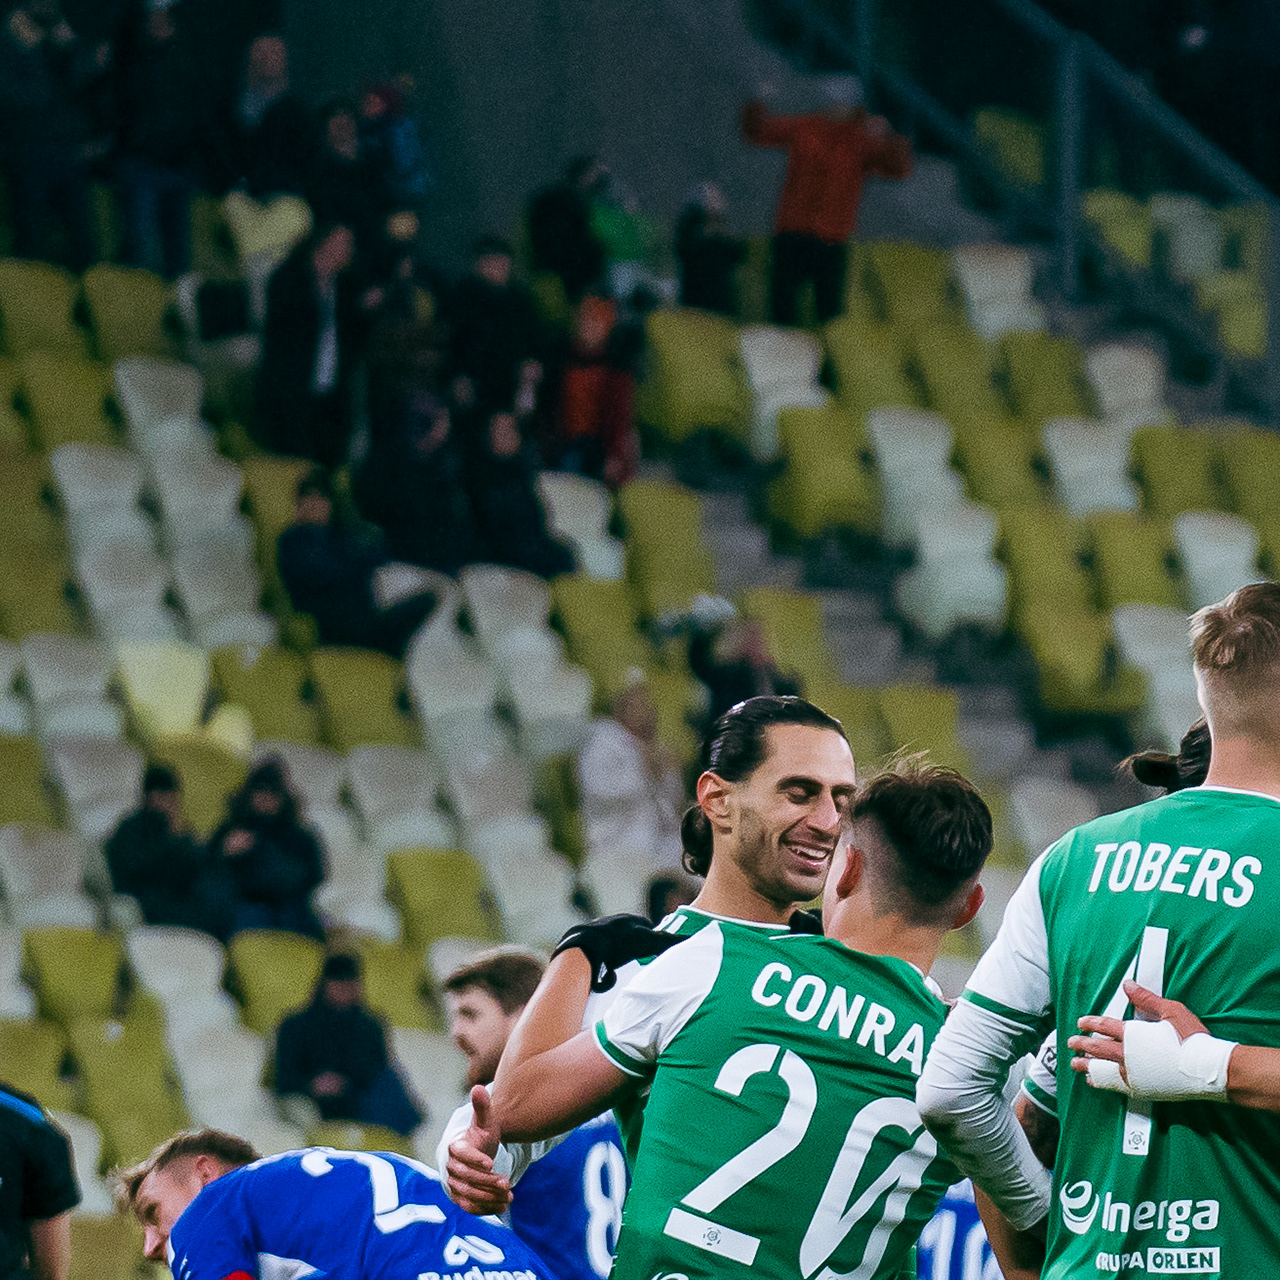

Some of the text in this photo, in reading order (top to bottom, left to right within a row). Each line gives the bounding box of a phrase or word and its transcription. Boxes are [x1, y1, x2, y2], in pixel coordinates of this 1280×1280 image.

[1088, 840, 1262, 909] TOBERS
[583, 1140, 627, 1280] 8
[1152, 1251, 1214, 1269] ORLEN
